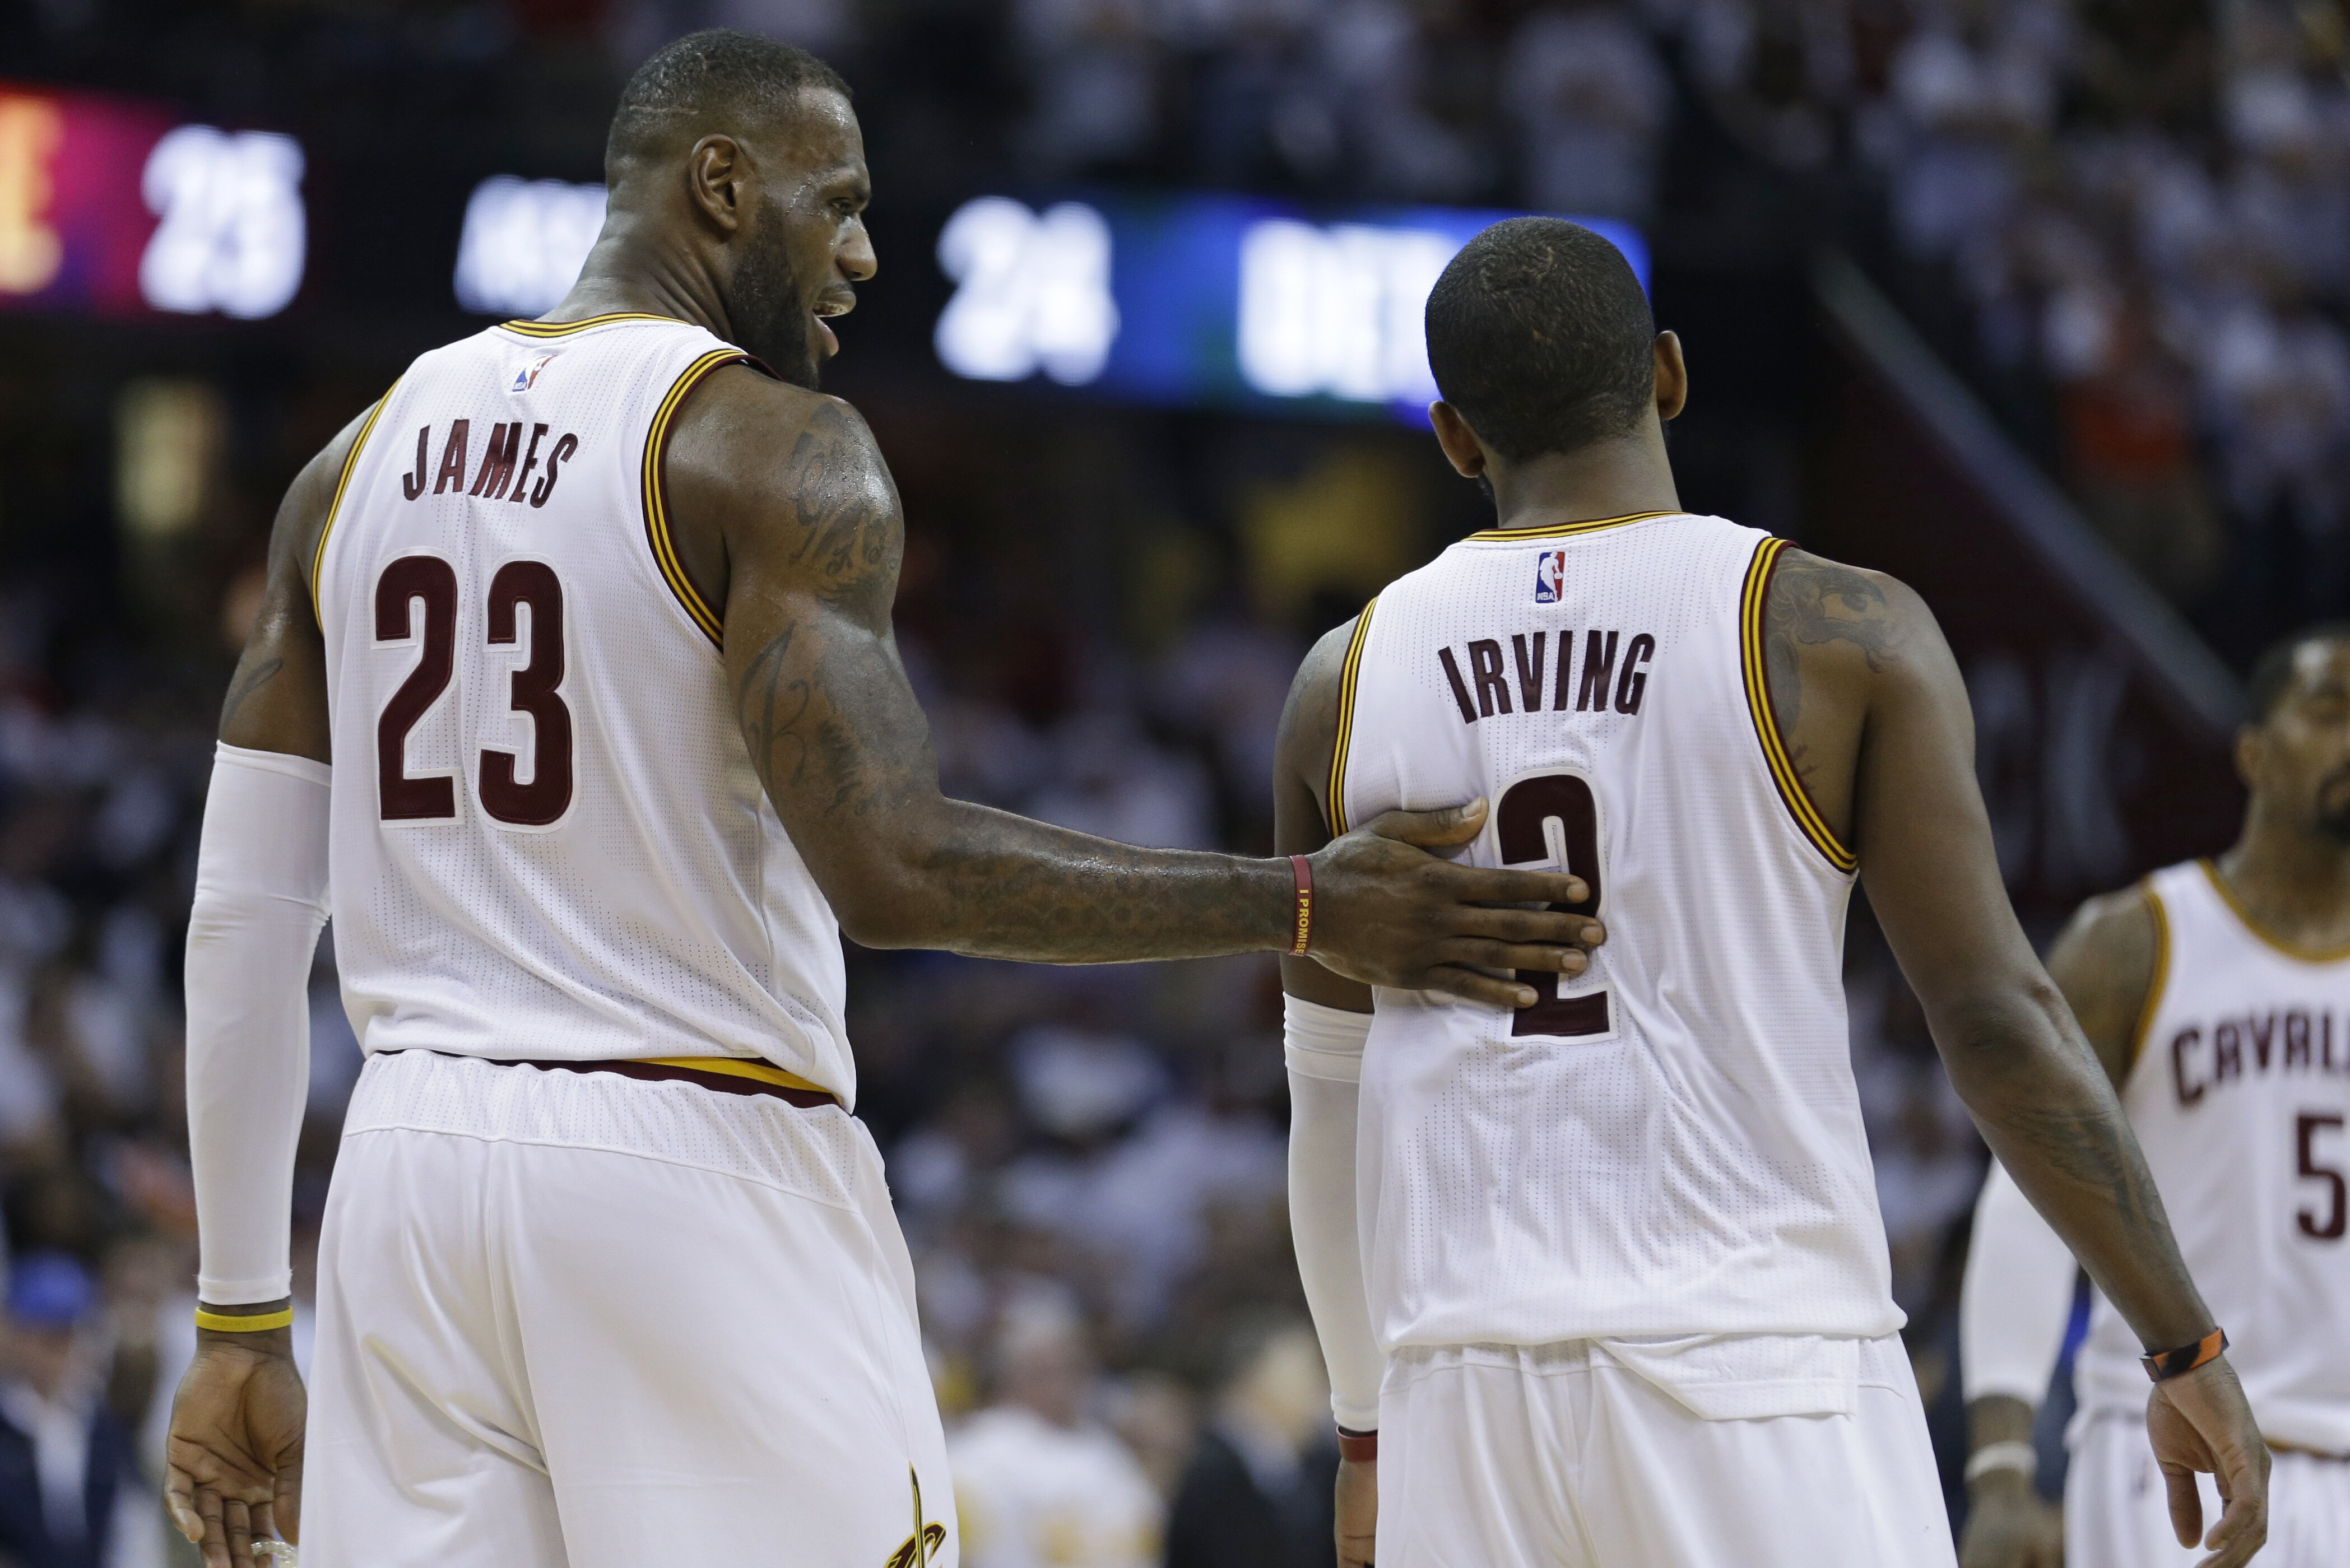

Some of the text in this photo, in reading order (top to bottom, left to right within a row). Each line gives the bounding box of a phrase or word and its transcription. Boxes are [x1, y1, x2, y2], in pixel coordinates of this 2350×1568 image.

[403, 418, 578, 508] JAMES
[375, 555, 573, 826] 23
[1438, 630, 1655, 724] IRVING
[1295, 899, 1309, 954] PROMISE
[1497, 774, 1610, 1037] 2
[2296, 1113, 2347, 1241] 5
